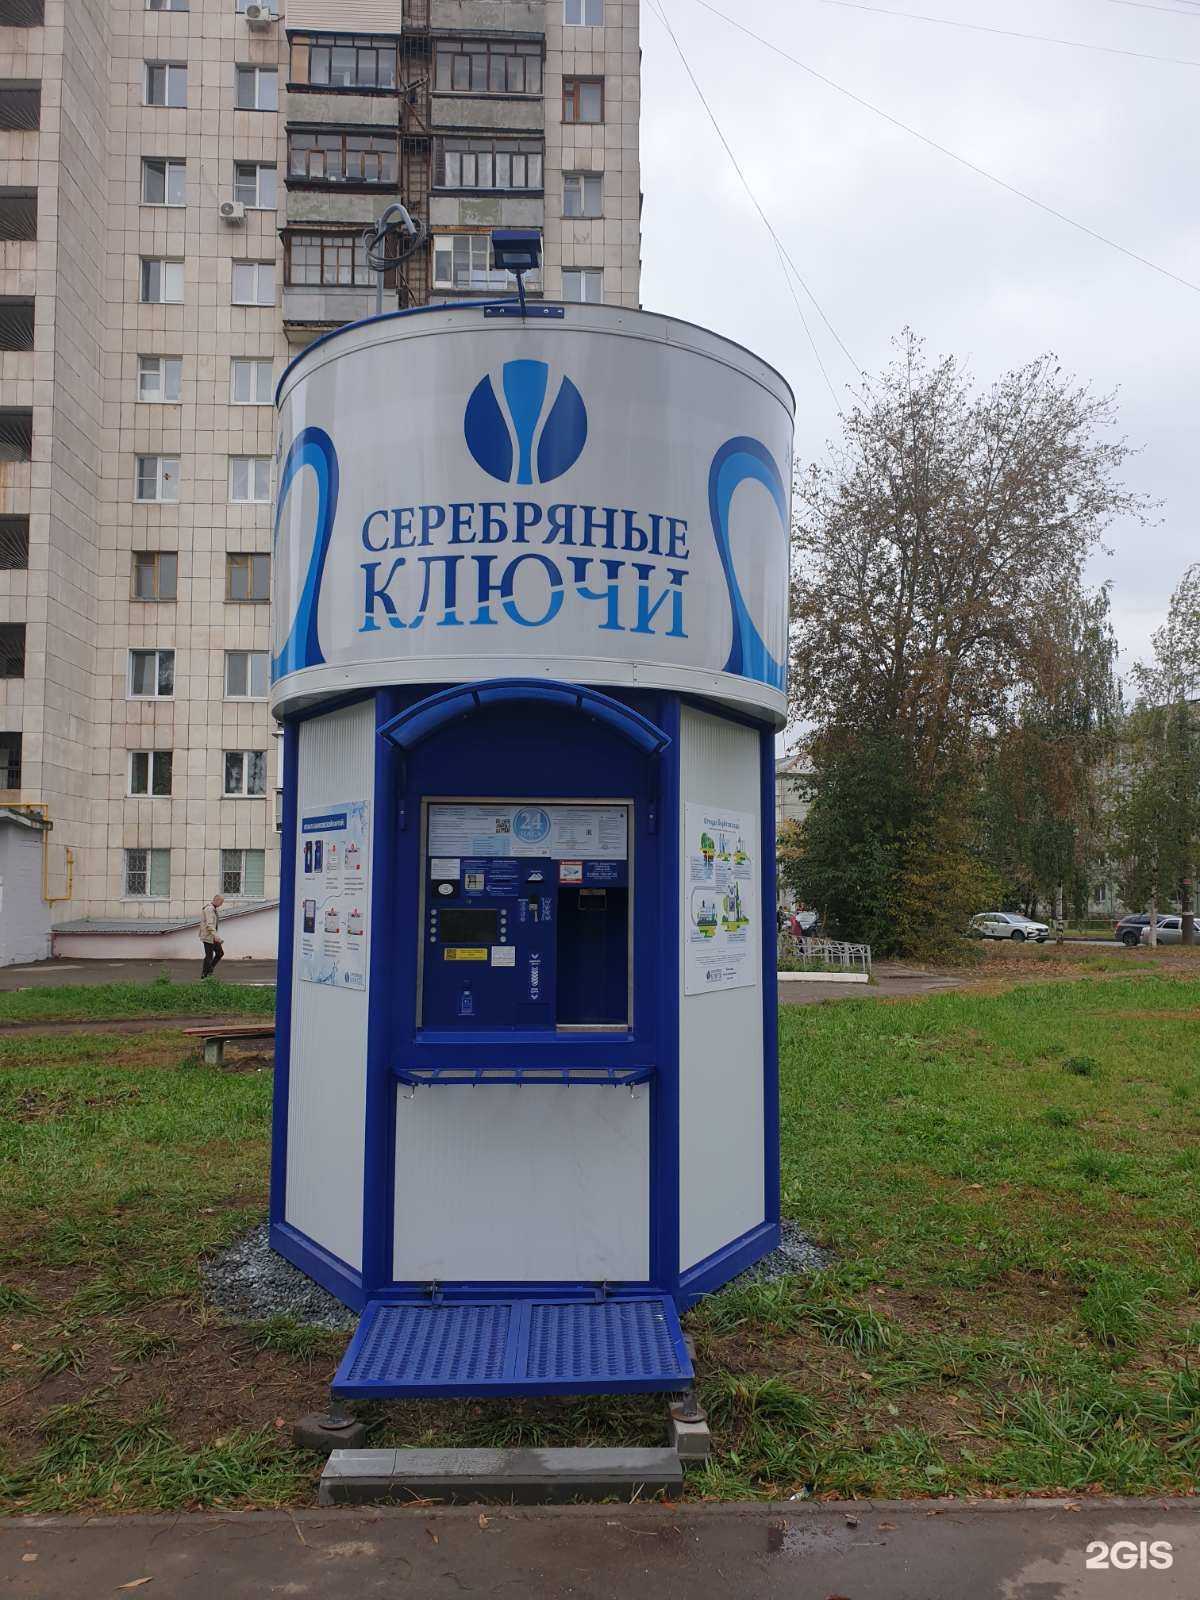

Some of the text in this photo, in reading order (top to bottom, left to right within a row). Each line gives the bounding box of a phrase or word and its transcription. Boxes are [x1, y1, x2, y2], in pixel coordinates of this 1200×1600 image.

[362, 501, 689, 560] СЕРЕБРЯНЫЕ
[359, 554, 689, 639] КЛЮЧИ
[520, 812, 542, 830] 24
